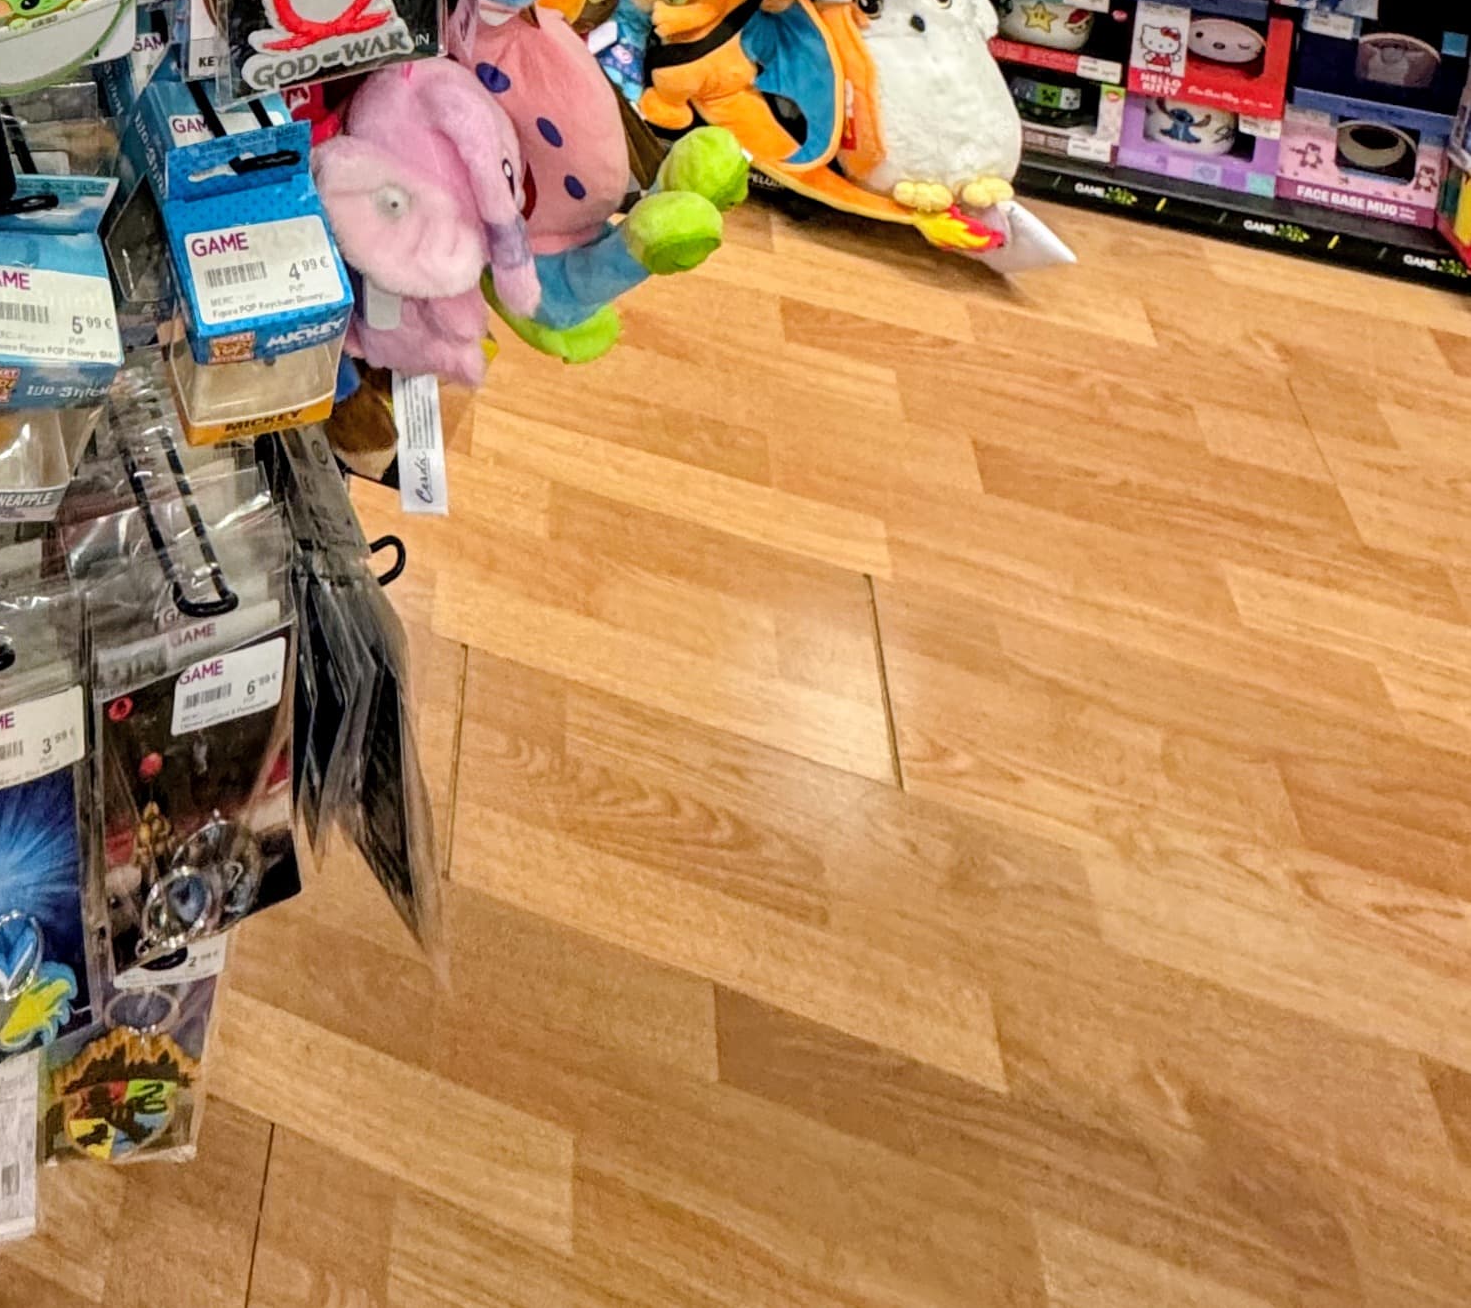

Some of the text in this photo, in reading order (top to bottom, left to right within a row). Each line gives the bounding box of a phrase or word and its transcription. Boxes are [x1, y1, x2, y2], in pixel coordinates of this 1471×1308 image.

[252, 31, 409, 89] GOD WAR
[1140, 72, 1182, 88] HELLO
[1296, 184, 1365, 207] FACE BASE
[191, 232, 250, 258] GAME
[266, 318, 346, 348] MICKEY
[224, 408, 303, 431] MICKEY
[177, 659, 225, 686] GAME
